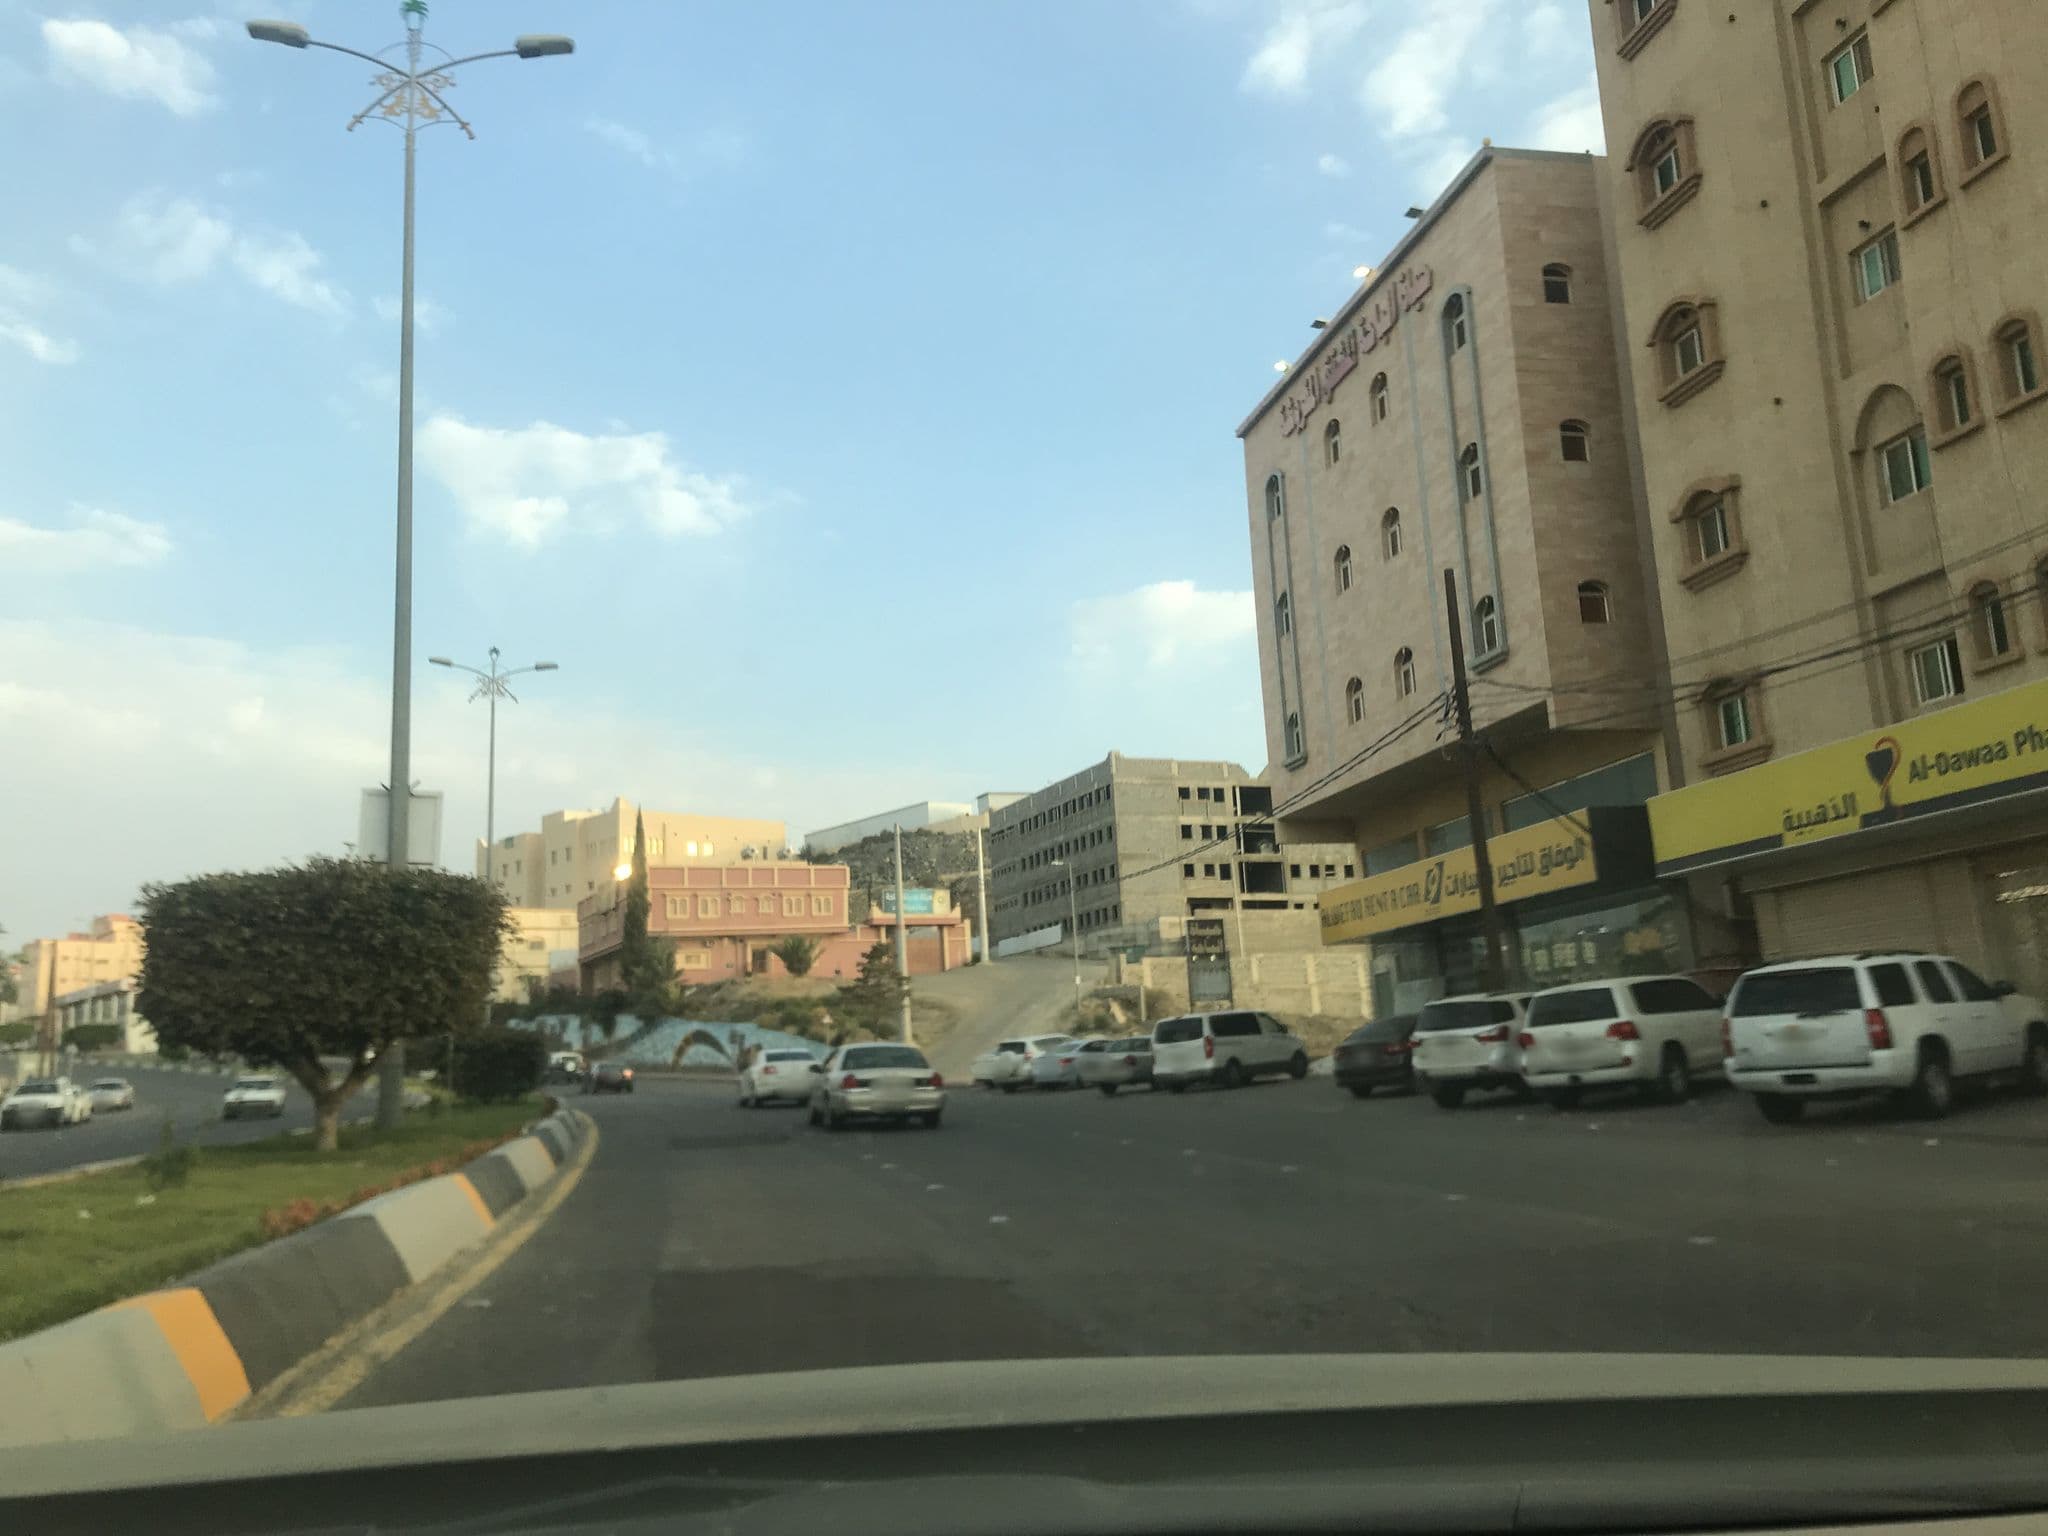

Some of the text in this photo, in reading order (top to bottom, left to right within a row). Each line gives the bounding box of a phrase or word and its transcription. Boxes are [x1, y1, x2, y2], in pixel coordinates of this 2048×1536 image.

[1908, 724, 2048, 784] Al-Dawaa Ph
[1540, 837, 1585, 876] الوفاق
